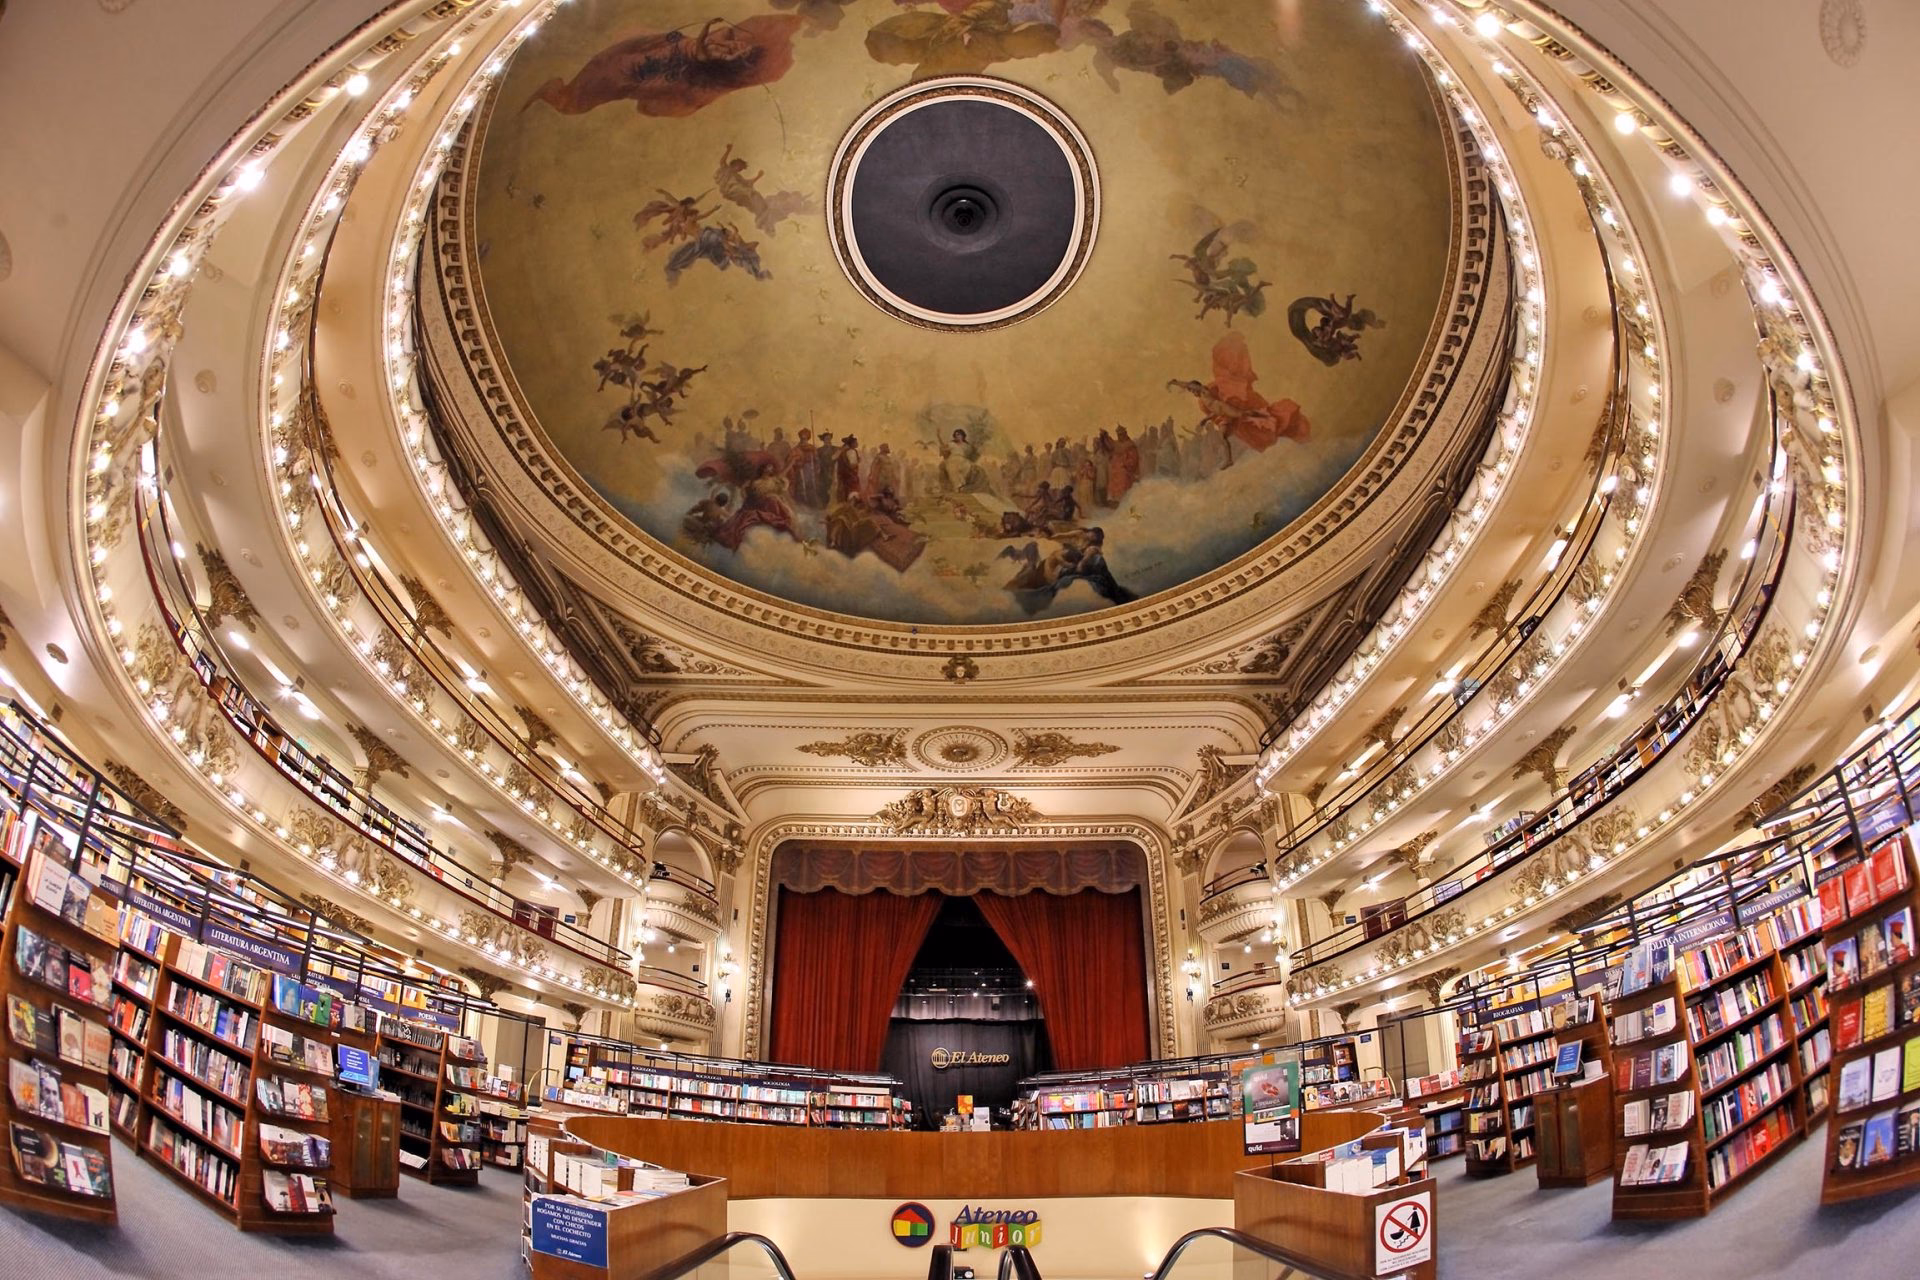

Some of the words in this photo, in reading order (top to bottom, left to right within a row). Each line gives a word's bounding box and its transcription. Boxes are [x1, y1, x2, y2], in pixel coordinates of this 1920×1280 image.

[133, 895, 162, 914] LITERATURA
[161, 907, 191, 928] ARGENTINA
[1650, 937, 1679, 952] OLITICA
[1678, 916, 1728, 943] INTERNACIONAL
[211, 928, 250, 951] LITERATURA
[250, 943, 290, 966] ARGENTINA
[1492, 1005, 1525, 1019] BIOGRAFIAS
[950, 1051, 966, 1064] El
[966, 1051, 1010, 1064] Ateneo
[1248, 1144, 1263, 1154] quid
[536, 1207, 562, 1218] ROGAMOS
[571, 1216, 602, 1228] DESCENDER
[544, 1202, 555, 1210] POR
[563, 1206, 594, 1219] SEGURIDAD
[955, 1204, 1038, 1224] Ateneo
[552, 1218, 565, 1226] CON
[565, 1221, 585, 1230] CHICOS
[562, 1226, 592, 1239] COCHECITO
